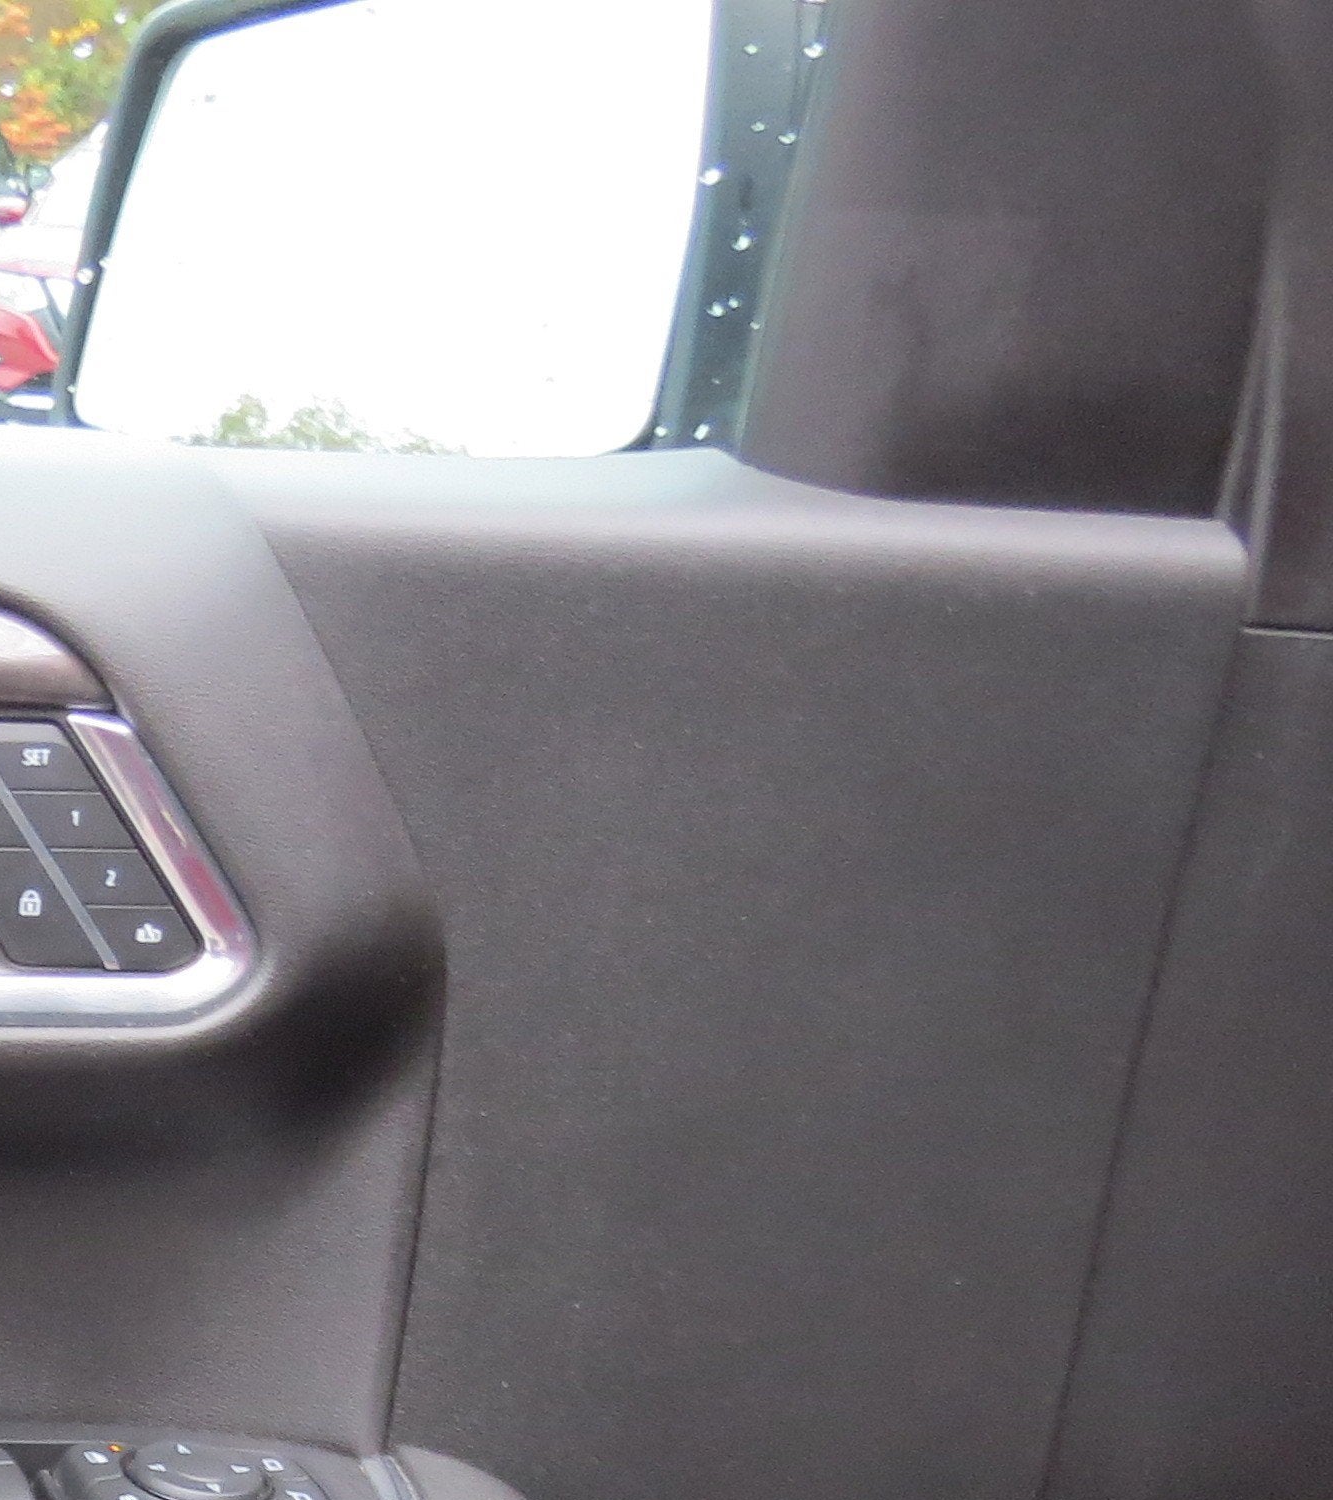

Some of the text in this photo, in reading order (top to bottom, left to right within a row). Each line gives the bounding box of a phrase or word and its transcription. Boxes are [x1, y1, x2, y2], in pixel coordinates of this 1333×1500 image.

[21, 747, 51, 767] SET
[71, 809, 81, 827] 1
[104, 869, 117, 888] 2
